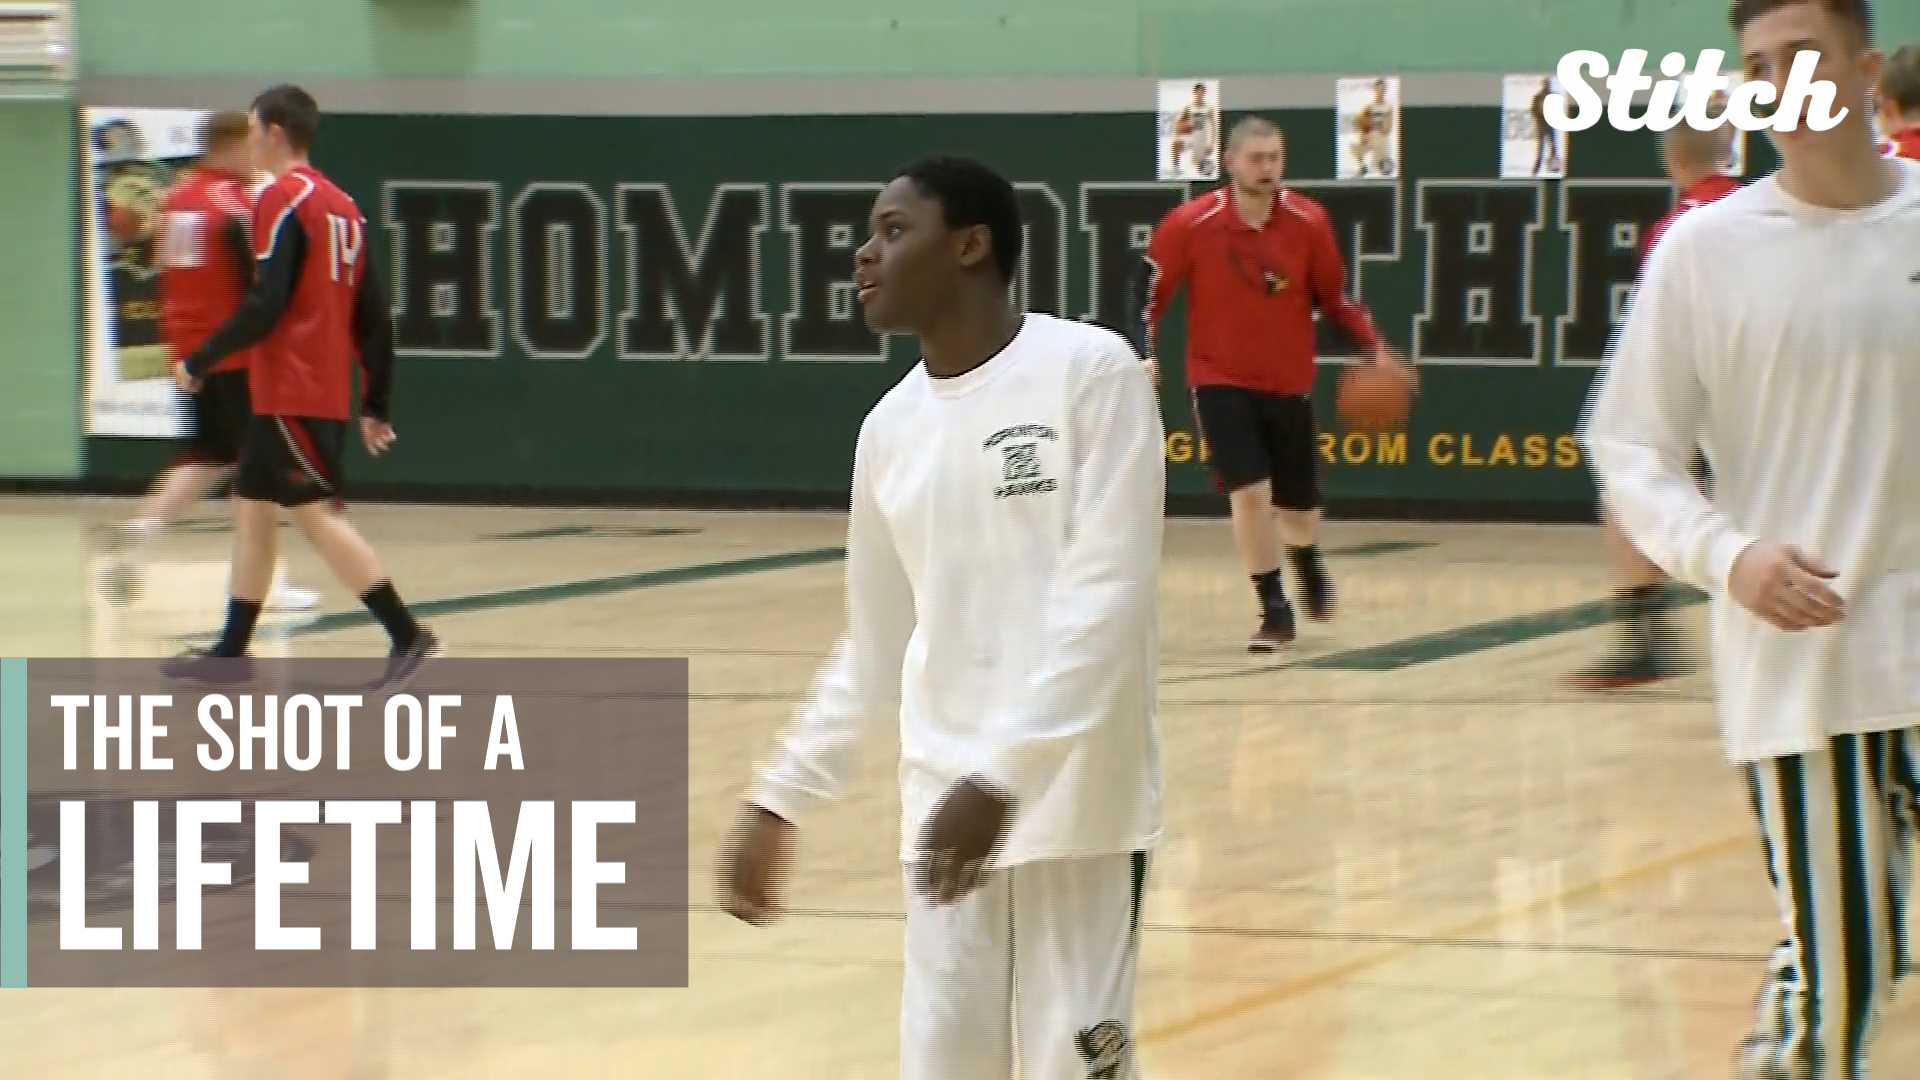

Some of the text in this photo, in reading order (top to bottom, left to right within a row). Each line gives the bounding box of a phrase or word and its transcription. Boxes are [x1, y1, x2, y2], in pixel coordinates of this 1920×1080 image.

[327, 213, 367, 287] 14
[384, 179, 888, 362] HOME
[1315, 432, 1408, 464] ROM
[1428, 433, 1580, 468] CLASS
